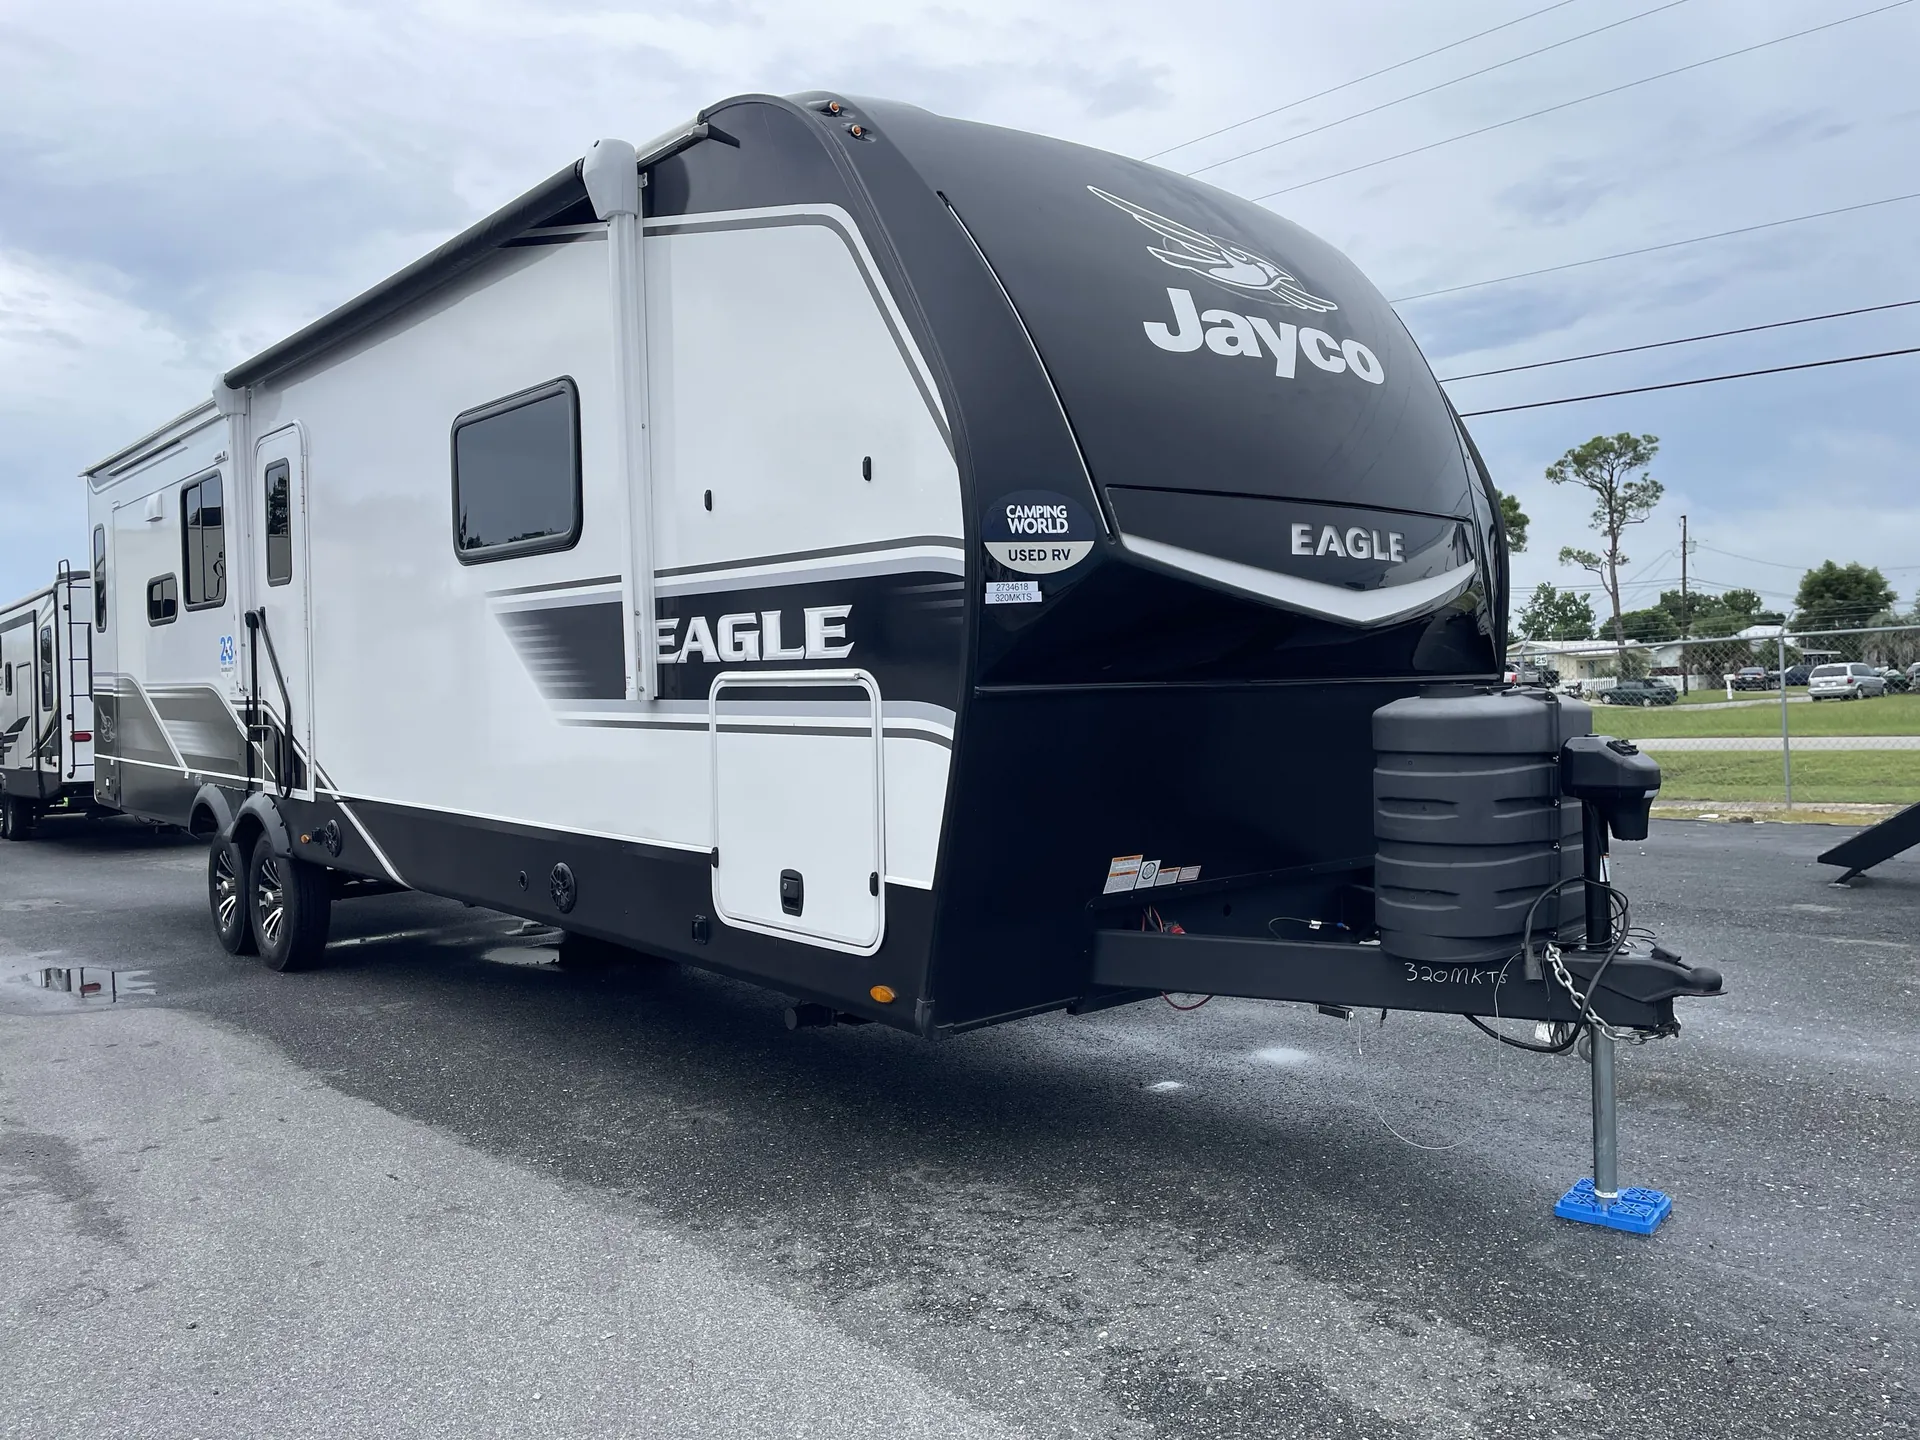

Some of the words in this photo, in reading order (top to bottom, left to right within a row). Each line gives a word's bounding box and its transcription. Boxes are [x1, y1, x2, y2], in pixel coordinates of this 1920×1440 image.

[1143, 287, 1385, 384] Jayco
[1006, 505, 1067, 518] CAMPING
[1291, 522, 1405, 562] EAGLE
[1008, 549, 1047, 561] USED
[1052, 548, 1071, 561] RV
[996, 583, 1029, 592] 2734618
[995, 593, 1032, 602] 320MKTS
[655, 604, 855, 664] EAGLE
